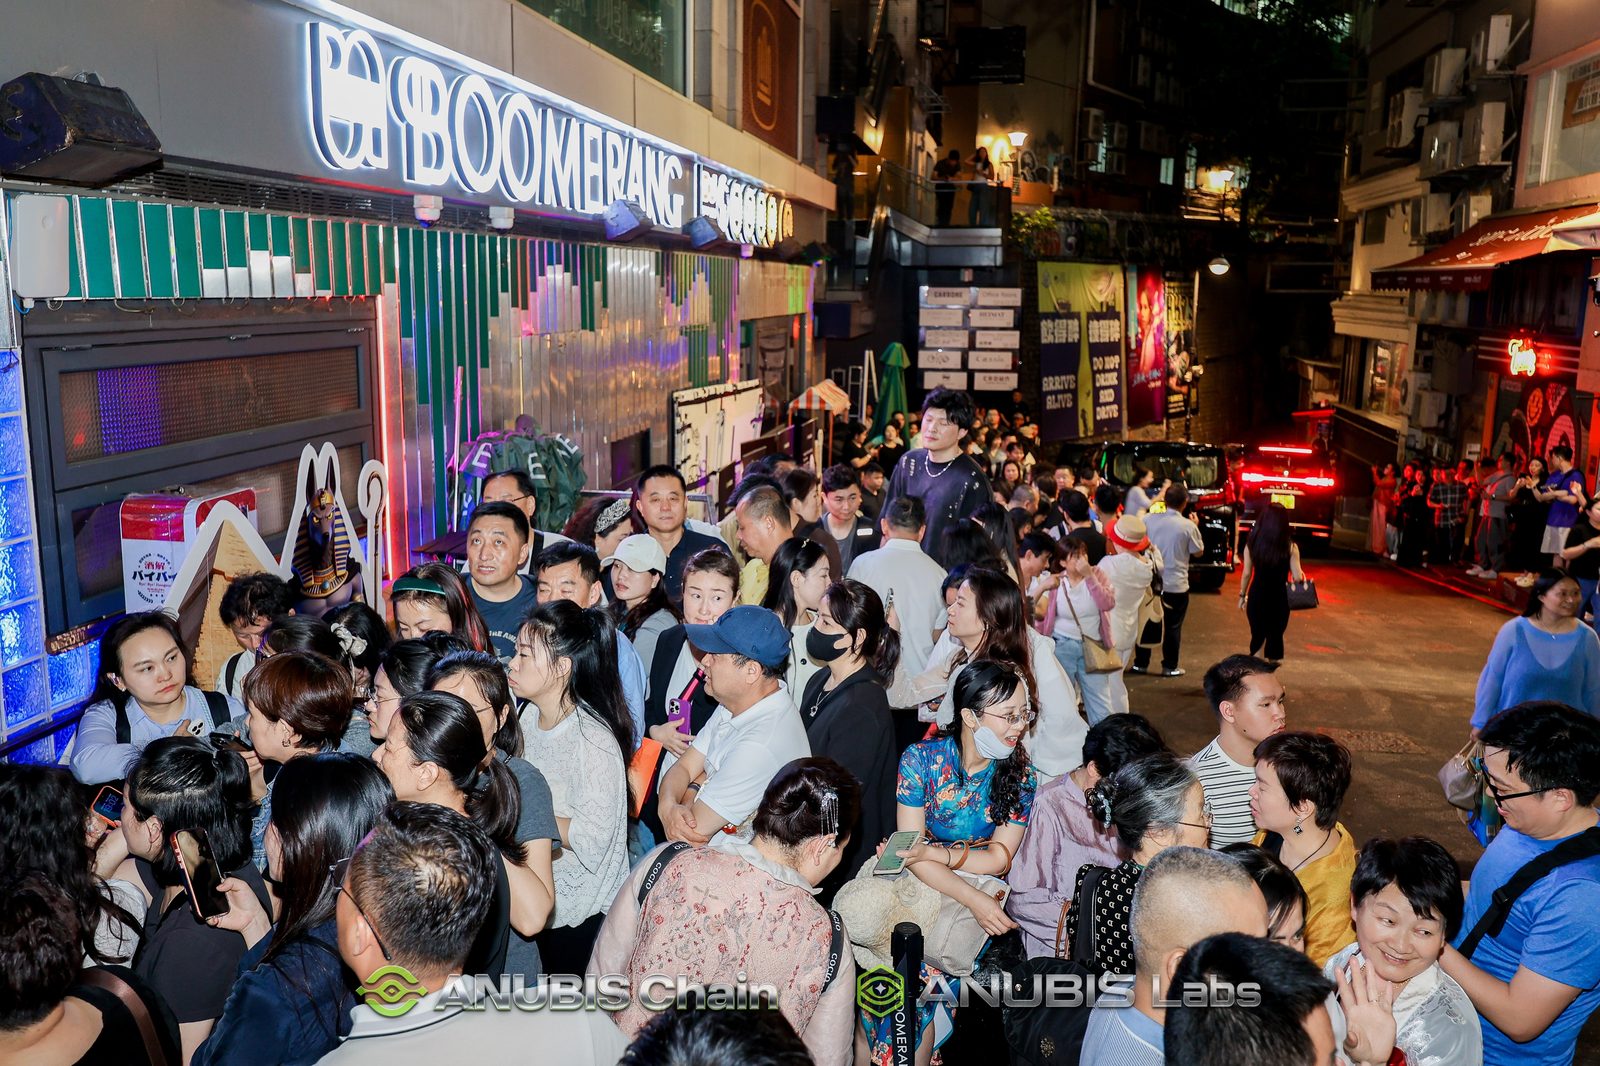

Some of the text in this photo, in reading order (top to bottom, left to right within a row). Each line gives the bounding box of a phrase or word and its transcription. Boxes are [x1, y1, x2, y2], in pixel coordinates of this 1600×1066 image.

[389, 57, 684, 229] BOOMERANG
[1092, 355, 1120, 370] DO NOT
[1042, 374, 1076, 392] ARRIVE
[1095, 371, 1118, 387] DRINK
[1046, 393, 1073, 410] ALIVE
[1099, 388, 1115, 403] AND
[1096, 404, 1119, 420] DRIVE
[645, 862, 662, 890] COCIO
[824, 952, 838, 983] COCIO
